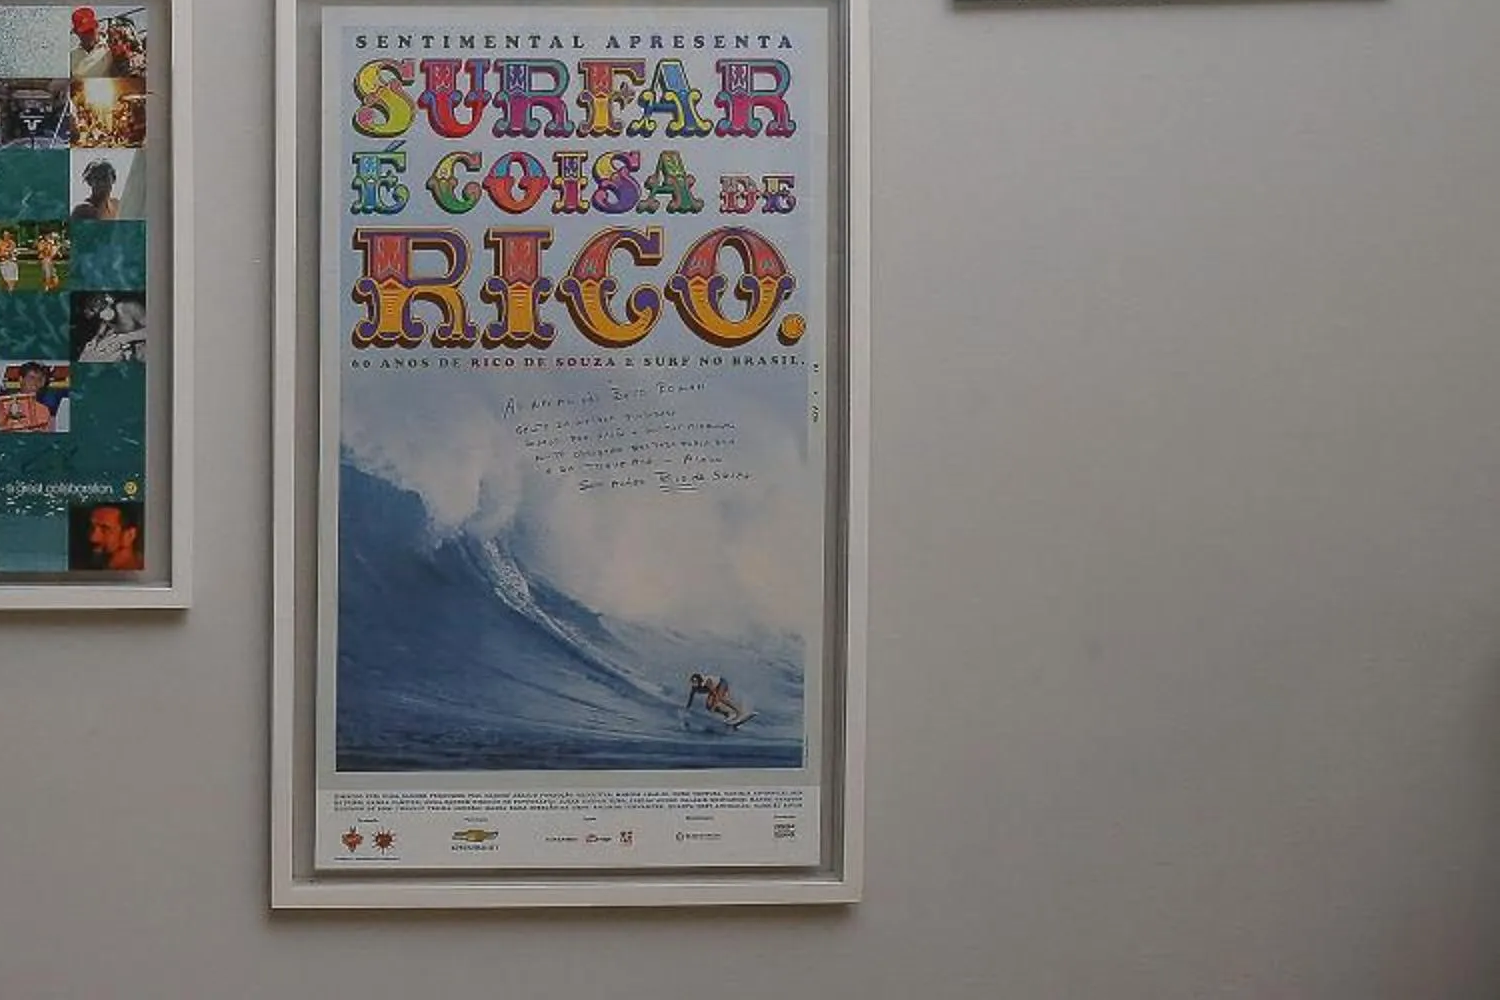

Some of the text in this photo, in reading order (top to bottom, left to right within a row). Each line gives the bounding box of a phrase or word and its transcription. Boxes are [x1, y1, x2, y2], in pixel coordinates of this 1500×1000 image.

[355, 34, 794, 49] SENTIMENTAL APRESENTA
[352, 57, 797, 139] SURFAR
[350, 139, 797, 216] É COISA DE
[350, 225, 808, 350] RICO.
[351, 357, 372, 370] 60
[380, 357, 431, 370] ANOS
[439, 357, 462, 369] DE
[471, 356, 516, 369] RICO
[525, 356, 548, 369] DE
[555, 356, 617, 368] SOUZA
[644, 356, 692, 368] SURF
[699, 356, 724, 368] NO
